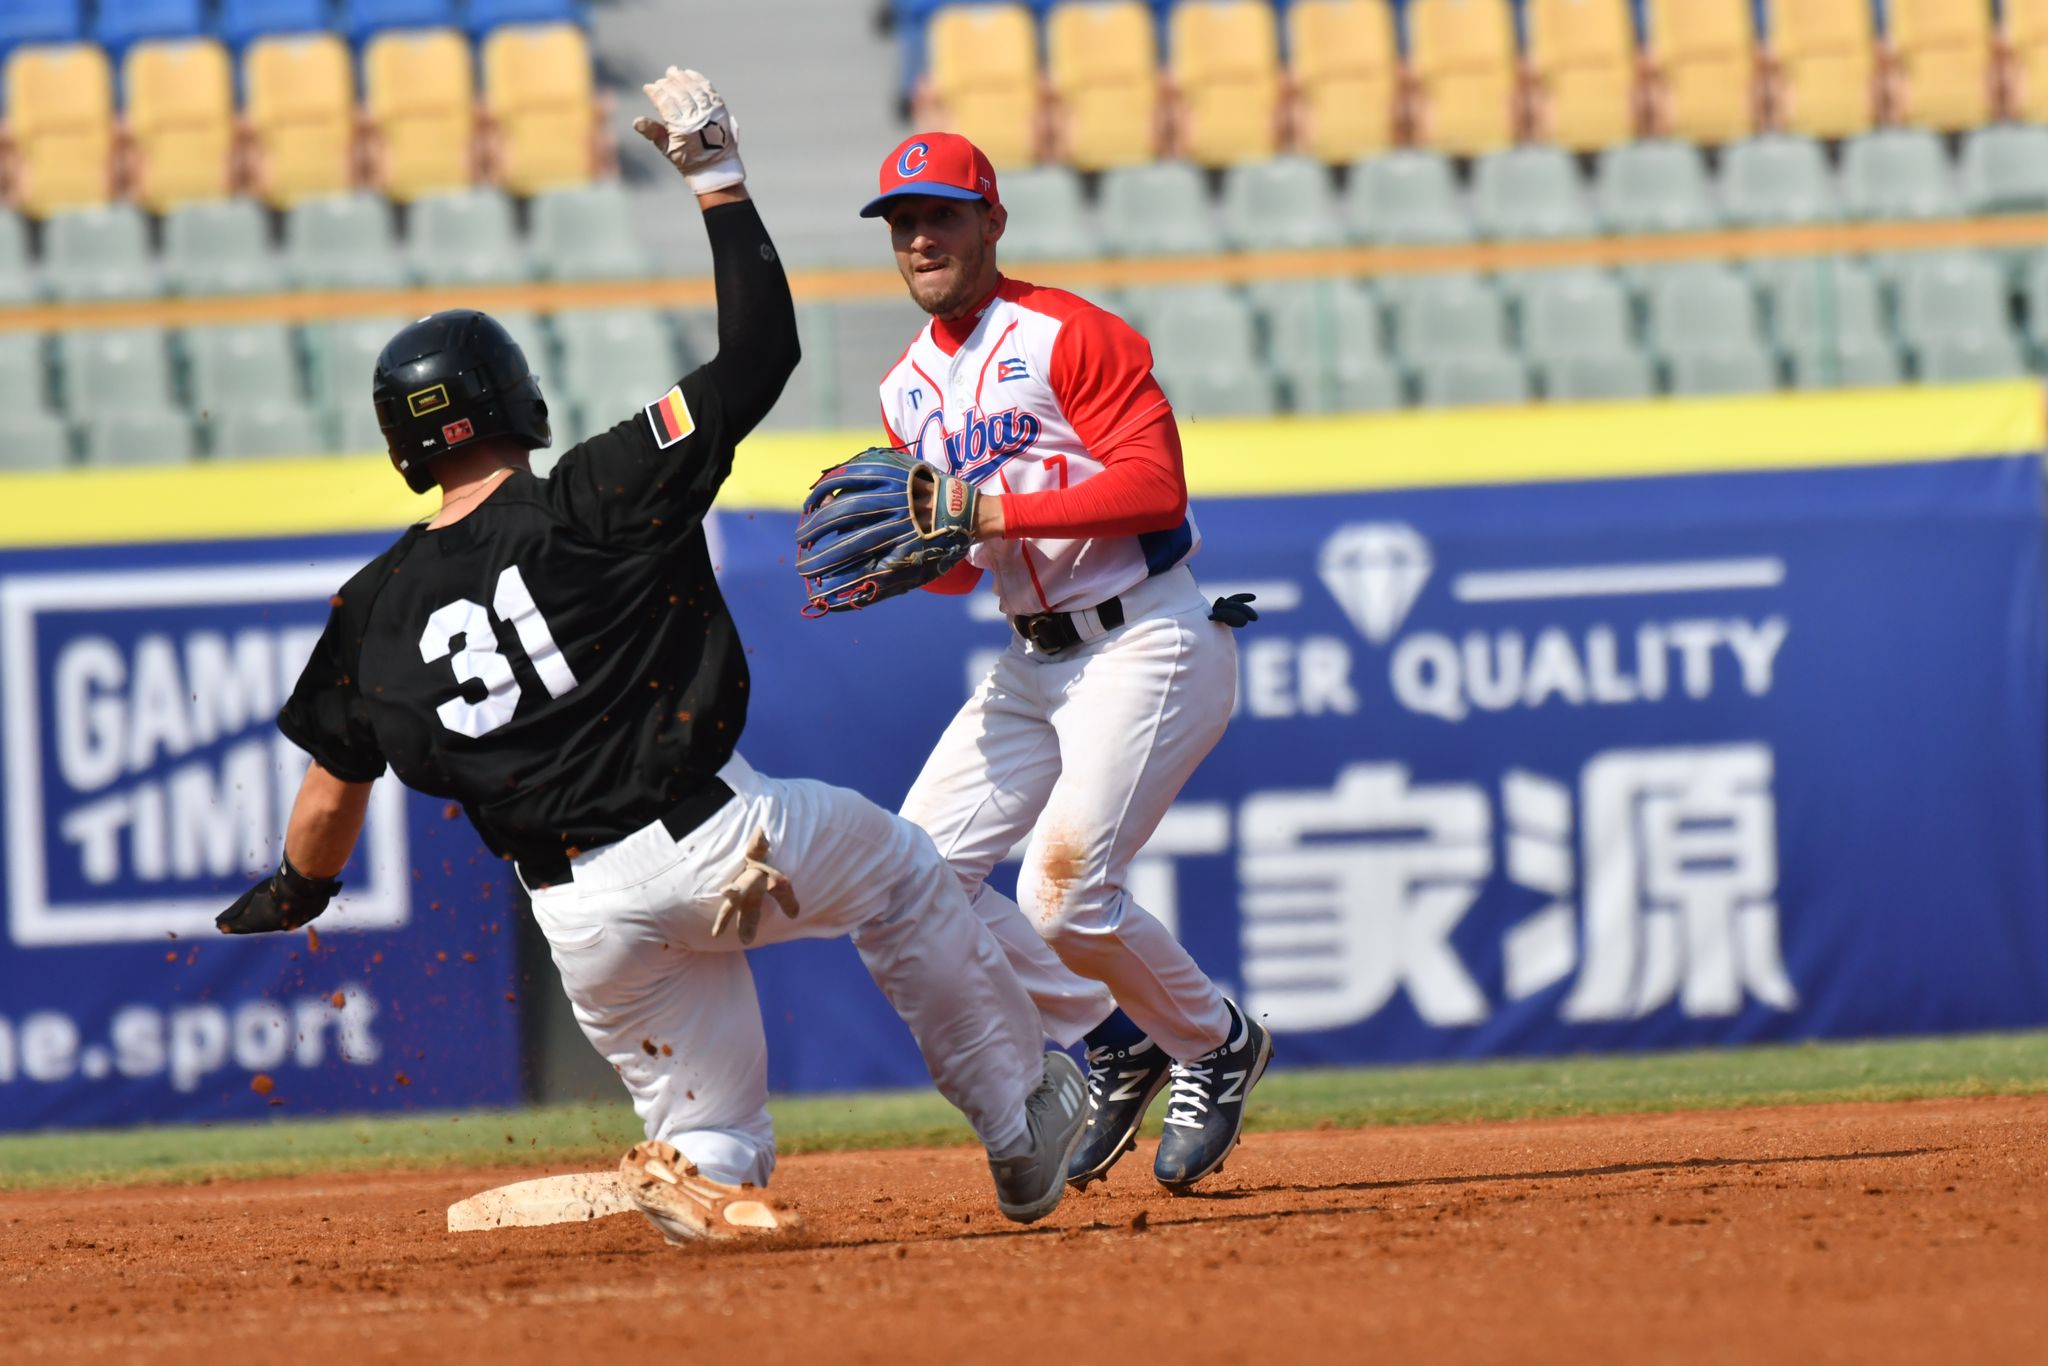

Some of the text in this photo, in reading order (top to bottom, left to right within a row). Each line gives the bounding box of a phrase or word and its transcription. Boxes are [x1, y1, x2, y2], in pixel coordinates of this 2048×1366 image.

[897, 142, 929, 178] C
[913, 406, 1041, 486] Cuba
[1042, 453, 1069, 490] 7
[418, 564, 578, 739] 31
[1389, 616, 1788, 722] QUALITY
